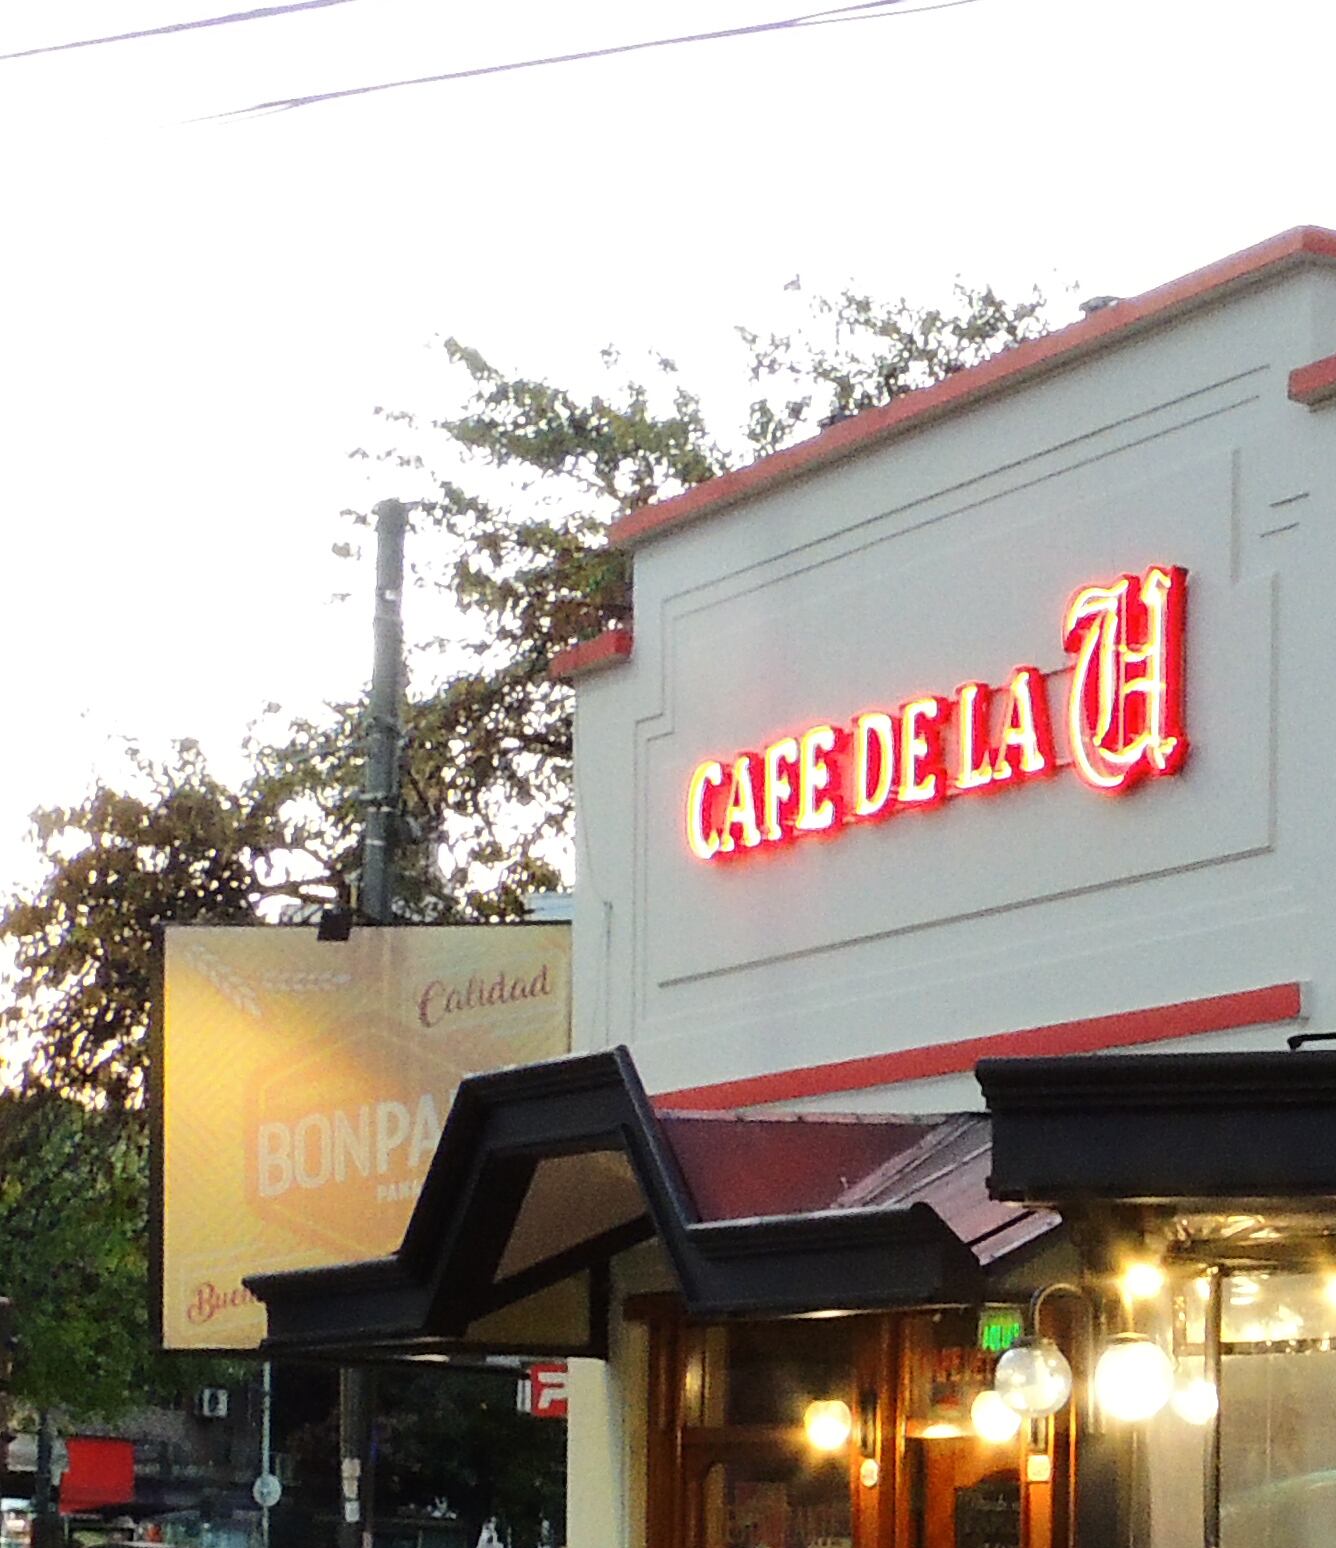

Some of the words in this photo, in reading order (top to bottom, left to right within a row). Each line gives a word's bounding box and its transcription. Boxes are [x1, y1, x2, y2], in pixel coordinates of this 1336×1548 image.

[686, 723, 840, 860] CAFE
[852, 695, 946, 818] DE
[954, 665, 1052, 790] LA
[418, 962, 551, 1028] Calidad
[257, 1089, 457, 1198] BONPA
